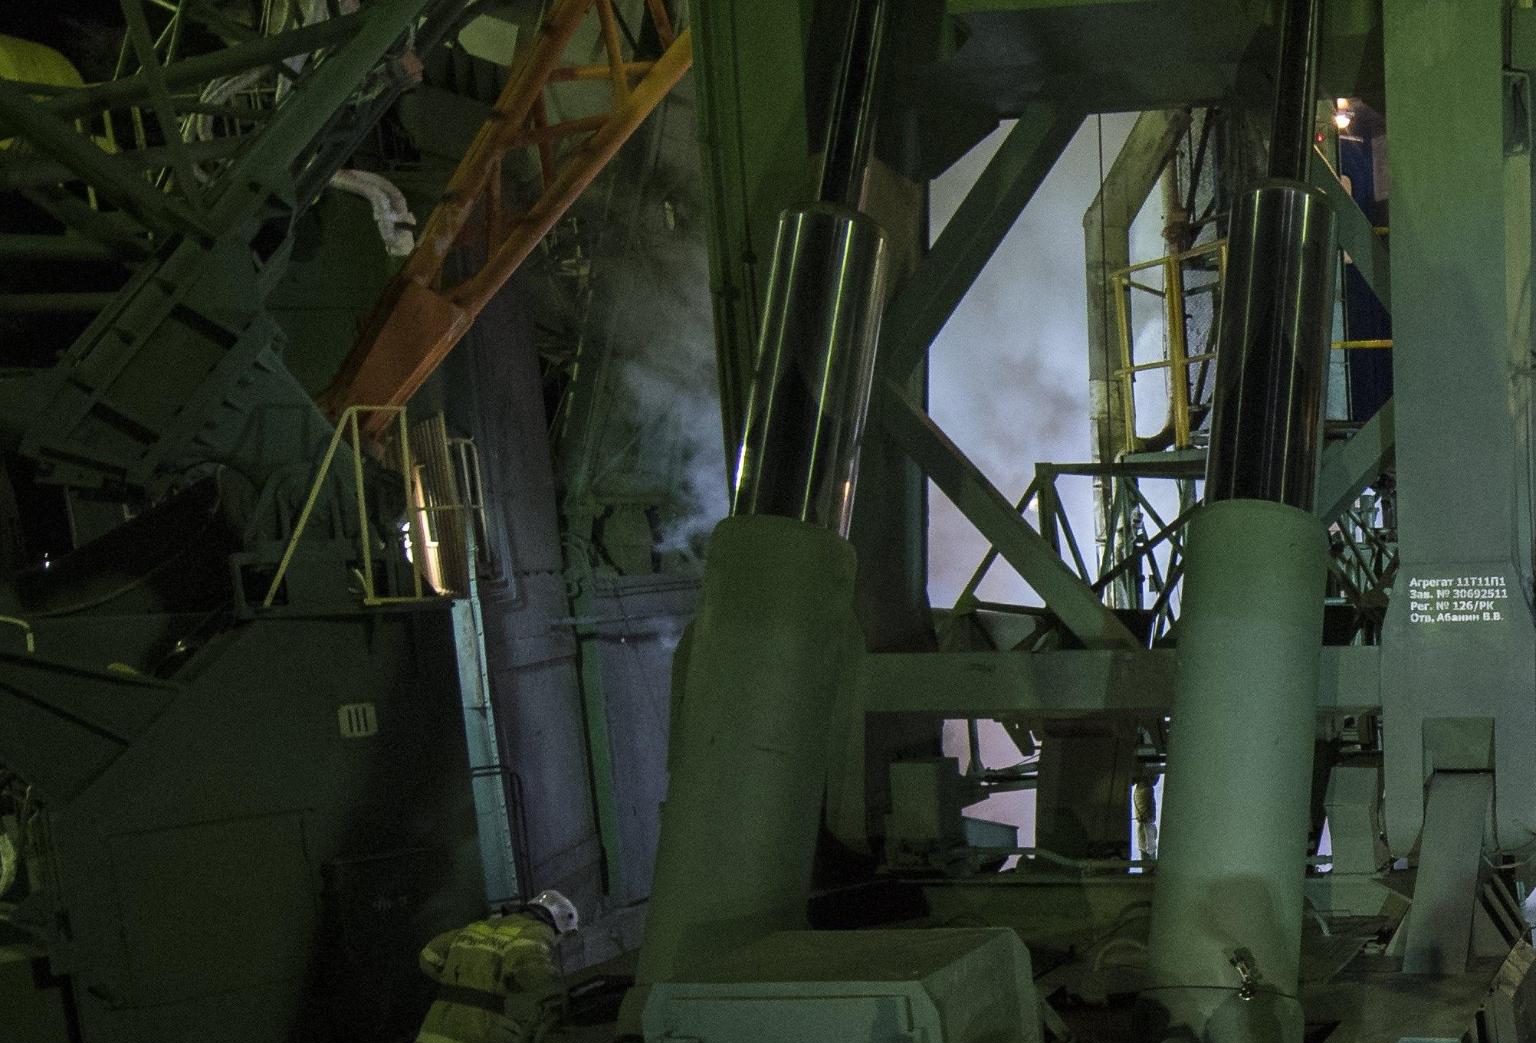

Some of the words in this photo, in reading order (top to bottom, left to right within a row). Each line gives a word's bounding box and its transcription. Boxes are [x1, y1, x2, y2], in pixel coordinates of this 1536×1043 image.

[1409, 577, 1454, 589] Агрегат
[1457, 576, 1506, 587] 11Т11П1
[1409, 589, 1434, 599] Зав.
[1453, 588, 1508, 599] 30692511
[1410, 601, 1434, 611] Рег.
[1453, 600, 1495, 612] 126/РК
[1410, 612, 1435, 623] Отв.
[1437, 612, 1480, 622] Абанин
[1482, 611, 1504, 622] В.В.
